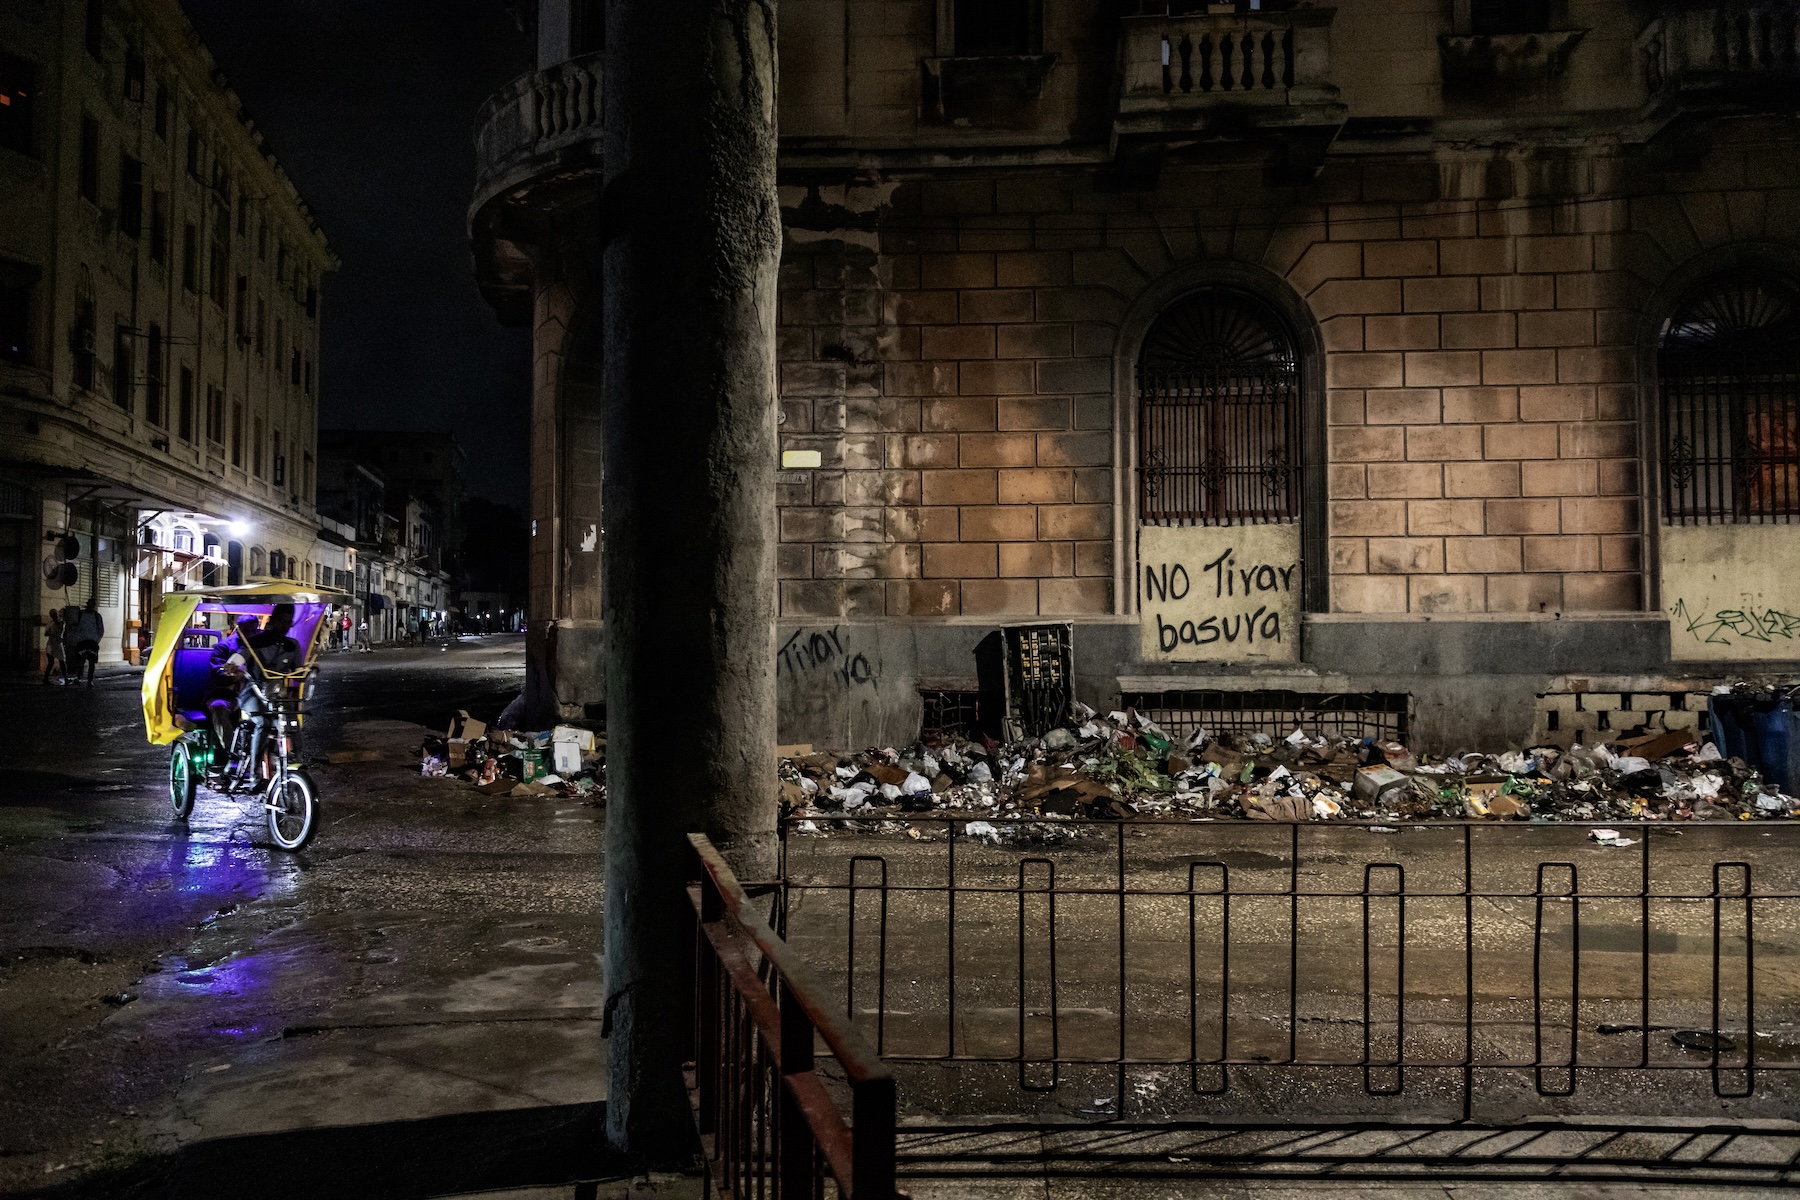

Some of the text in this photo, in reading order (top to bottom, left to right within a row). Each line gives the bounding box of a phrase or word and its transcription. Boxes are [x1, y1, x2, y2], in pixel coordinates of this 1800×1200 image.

[1146, 548, 1297, 602] NO Tirar
[1157, 606, 1281, 652] basura
